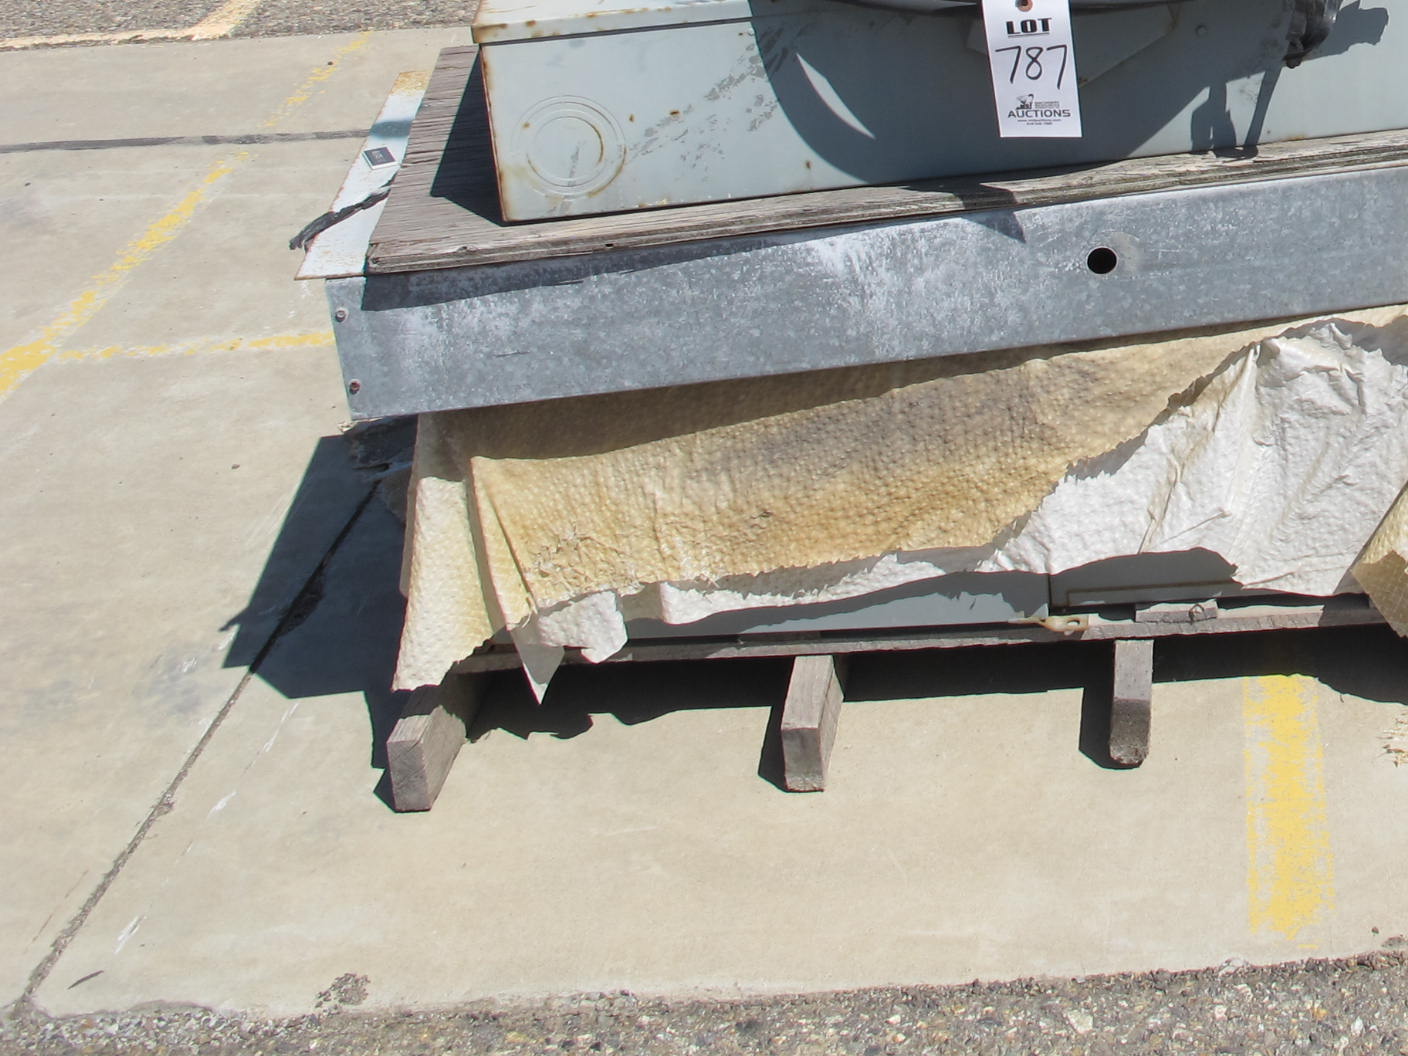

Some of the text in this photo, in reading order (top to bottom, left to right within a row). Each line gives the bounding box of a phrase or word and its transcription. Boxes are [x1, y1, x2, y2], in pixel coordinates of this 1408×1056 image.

[1006, 17, 1052, 35] LOT
[994, 44, 1068, 90] 787
[1007, 109, 1072, 119] AUCTIONS
